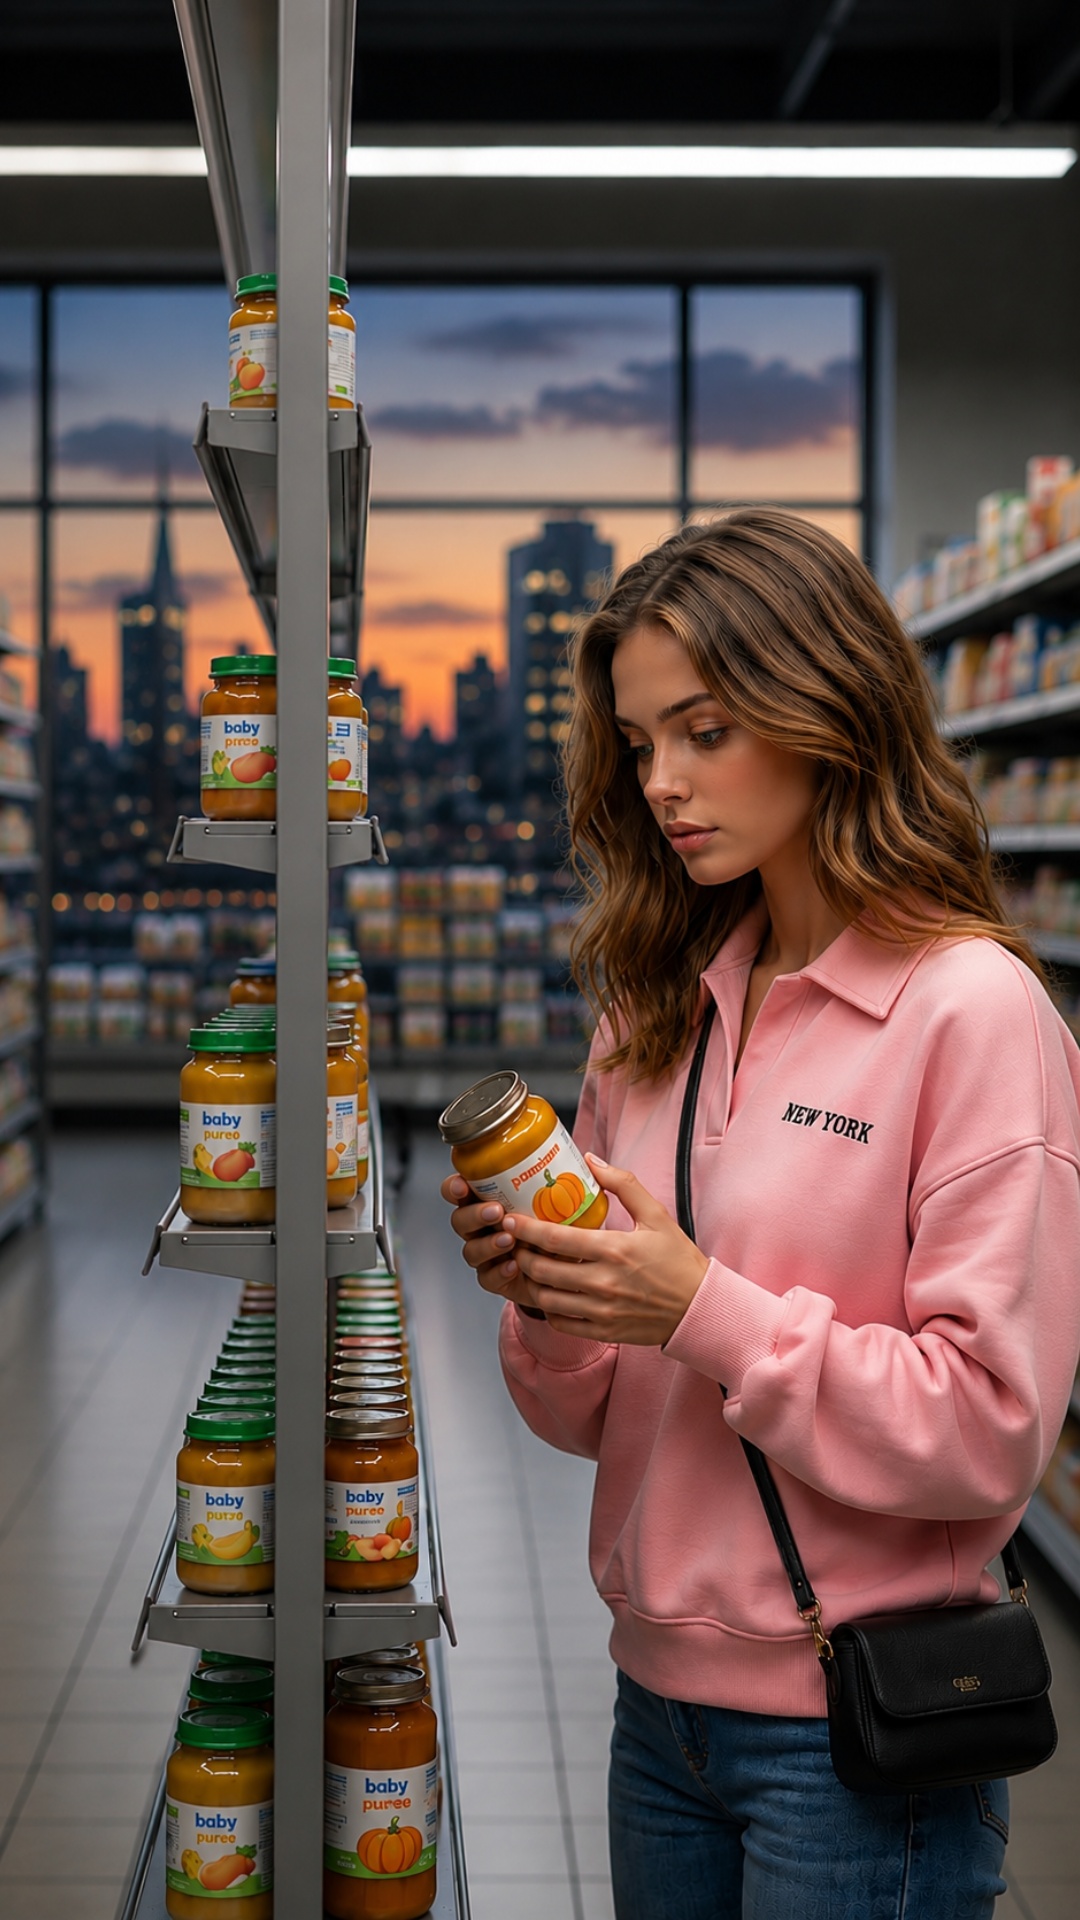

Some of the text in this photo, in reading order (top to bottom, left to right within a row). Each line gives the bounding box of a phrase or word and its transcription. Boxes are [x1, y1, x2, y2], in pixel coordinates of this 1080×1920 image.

[224, 720, 260, 737] baby
[203, 1111, 241, 1129] baby
[781, 1102, 874, 1144] NEW YORK
[206, 1492, 244, 1509] baby
[346, 1489, 384, 1505] baby
[365, 1777, 408, 1796] baby
[363, 1798, 411, 1813] puree
[195, 1812, 237, 1832] baby
